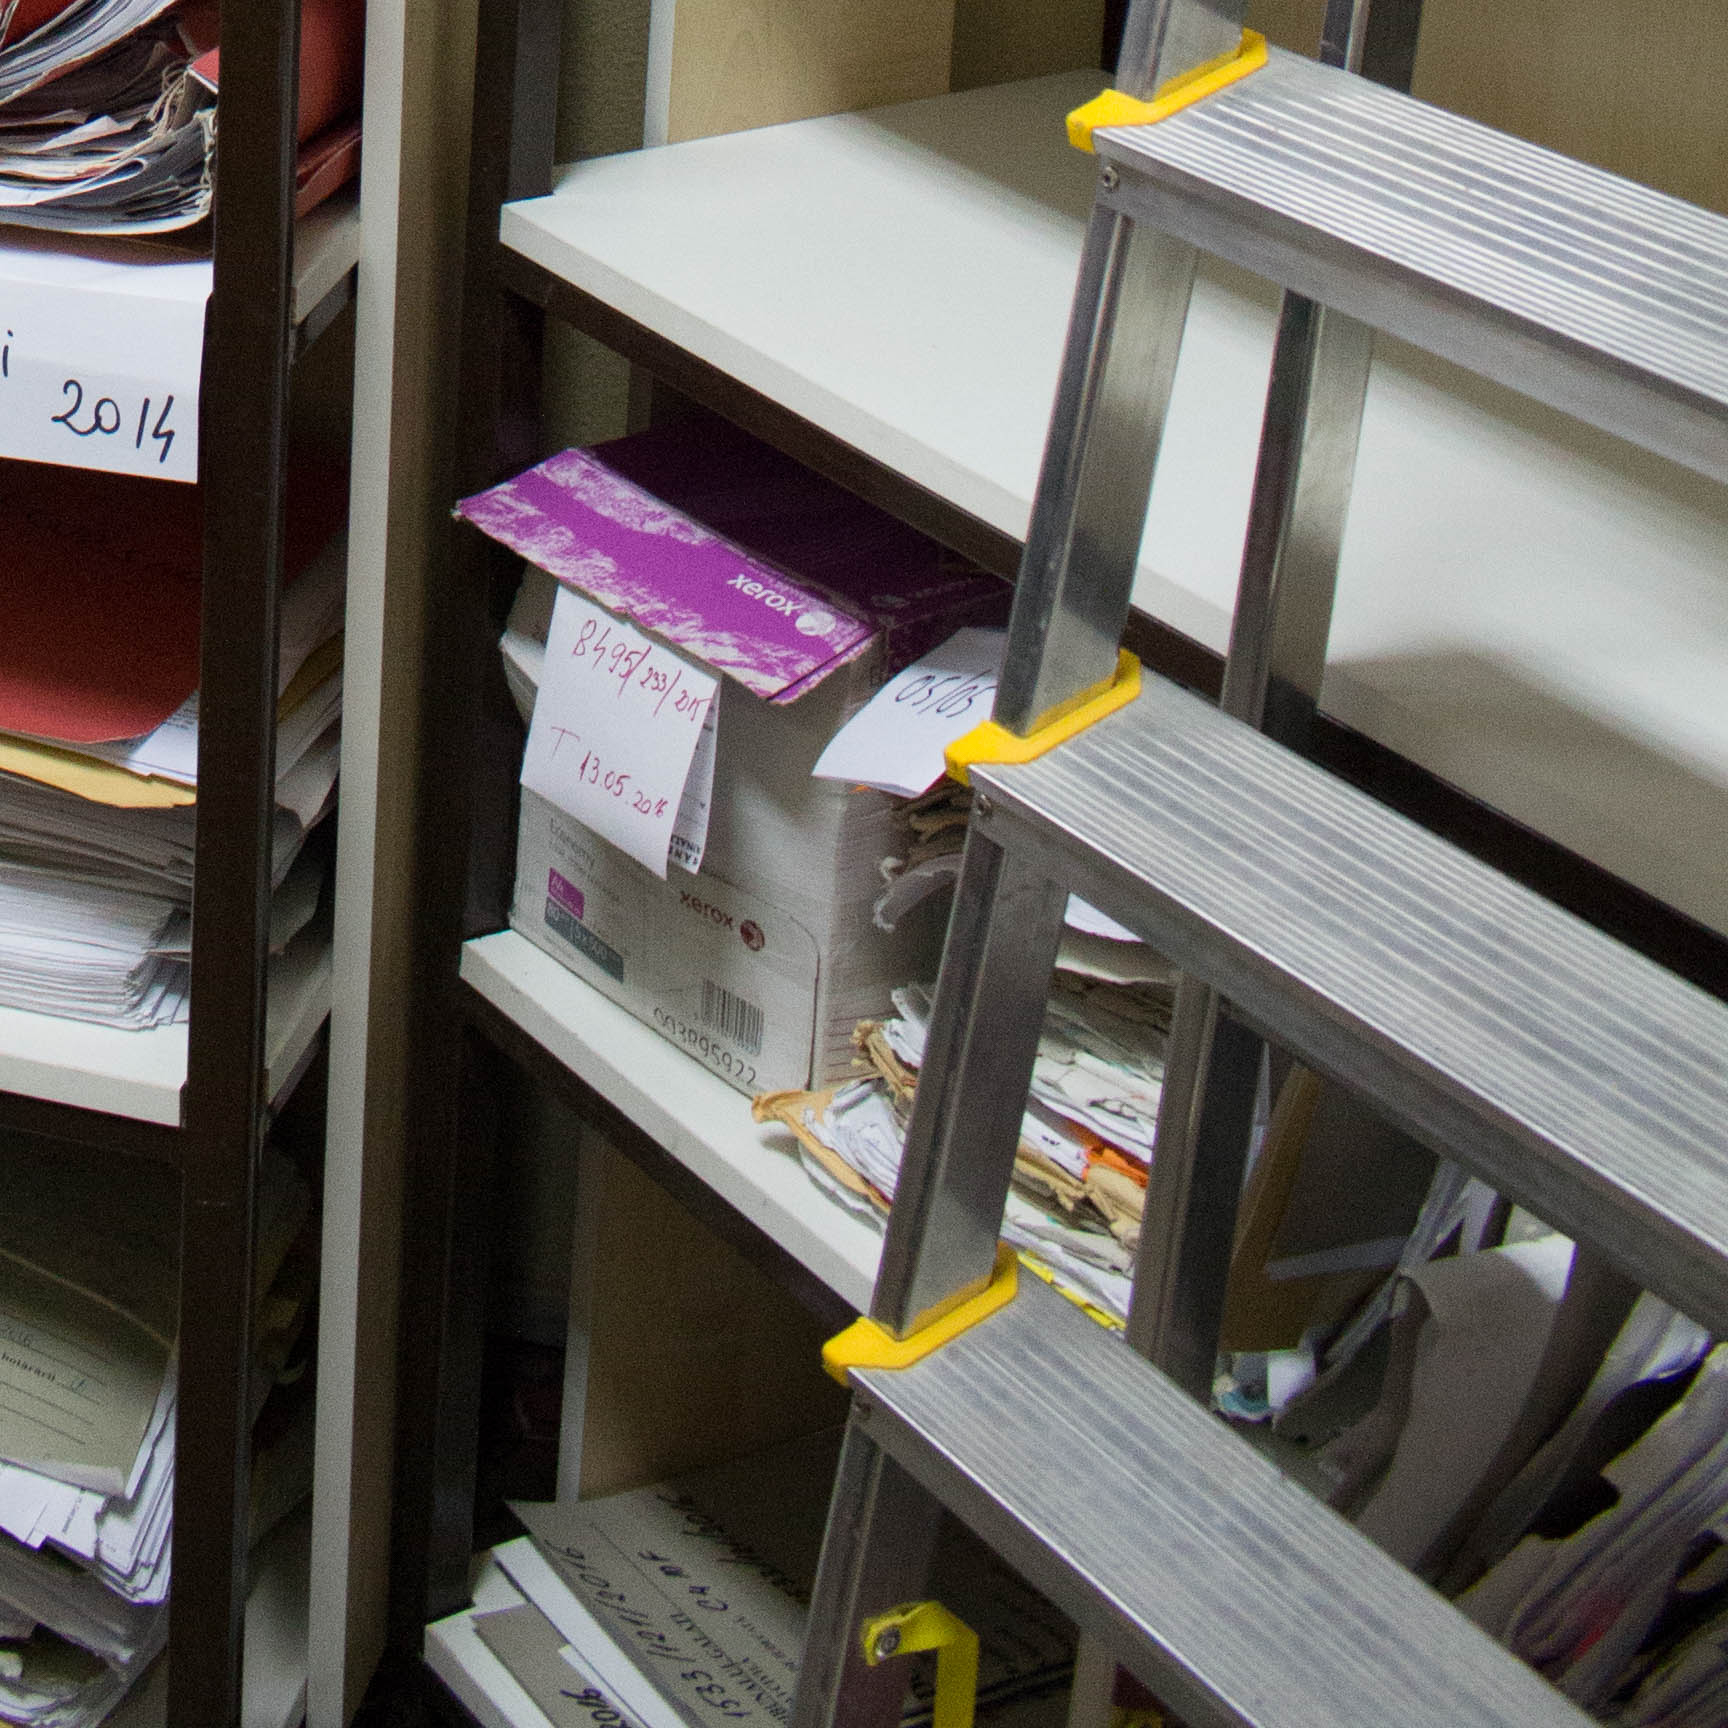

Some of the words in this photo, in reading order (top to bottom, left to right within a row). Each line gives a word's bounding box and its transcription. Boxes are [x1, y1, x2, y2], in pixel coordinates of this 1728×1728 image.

[50, 379, 176, 464] 2014
[726, 573, 806, 617] xerox
[679, 890, 734, 931] xerox
